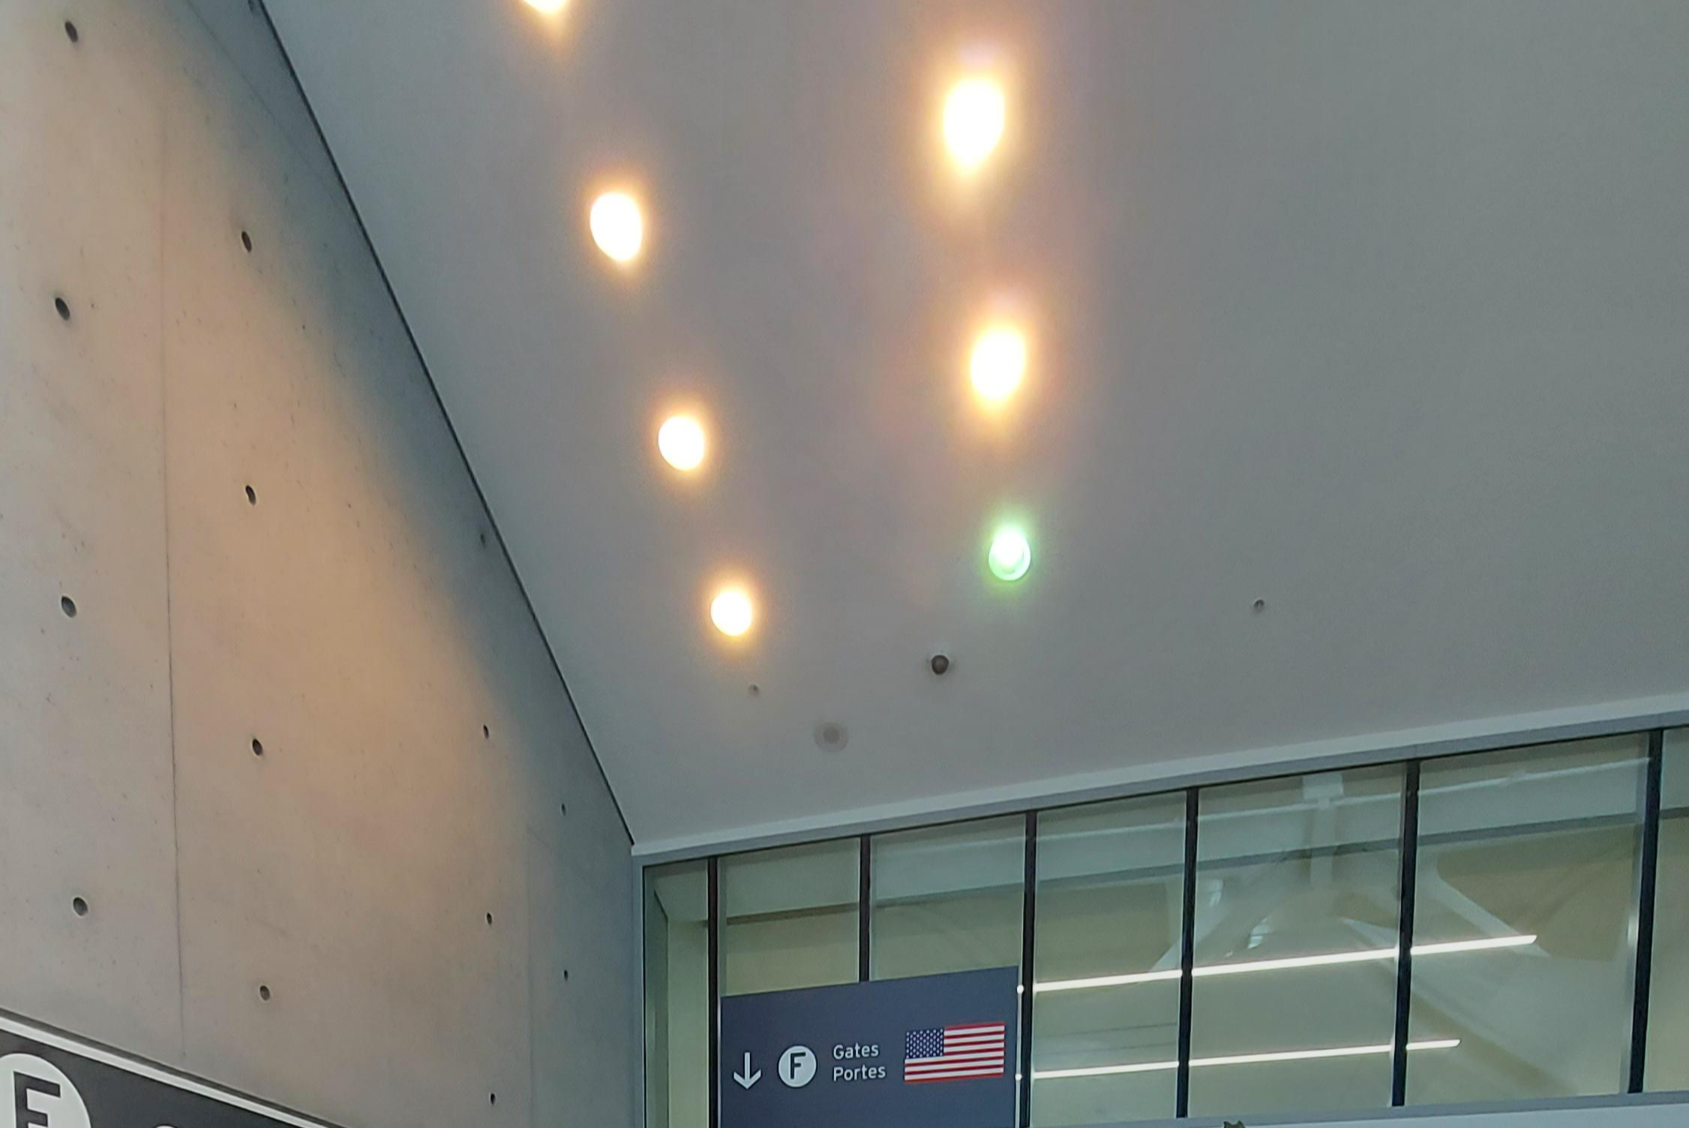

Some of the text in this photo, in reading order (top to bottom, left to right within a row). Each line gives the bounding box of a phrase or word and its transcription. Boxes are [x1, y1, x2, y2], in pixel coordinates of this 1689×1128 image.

[833, 1043, 879, 1060] Gates
[790, 1052, 806, 1080] F
[833, 1065, 886, 1082] Portes
